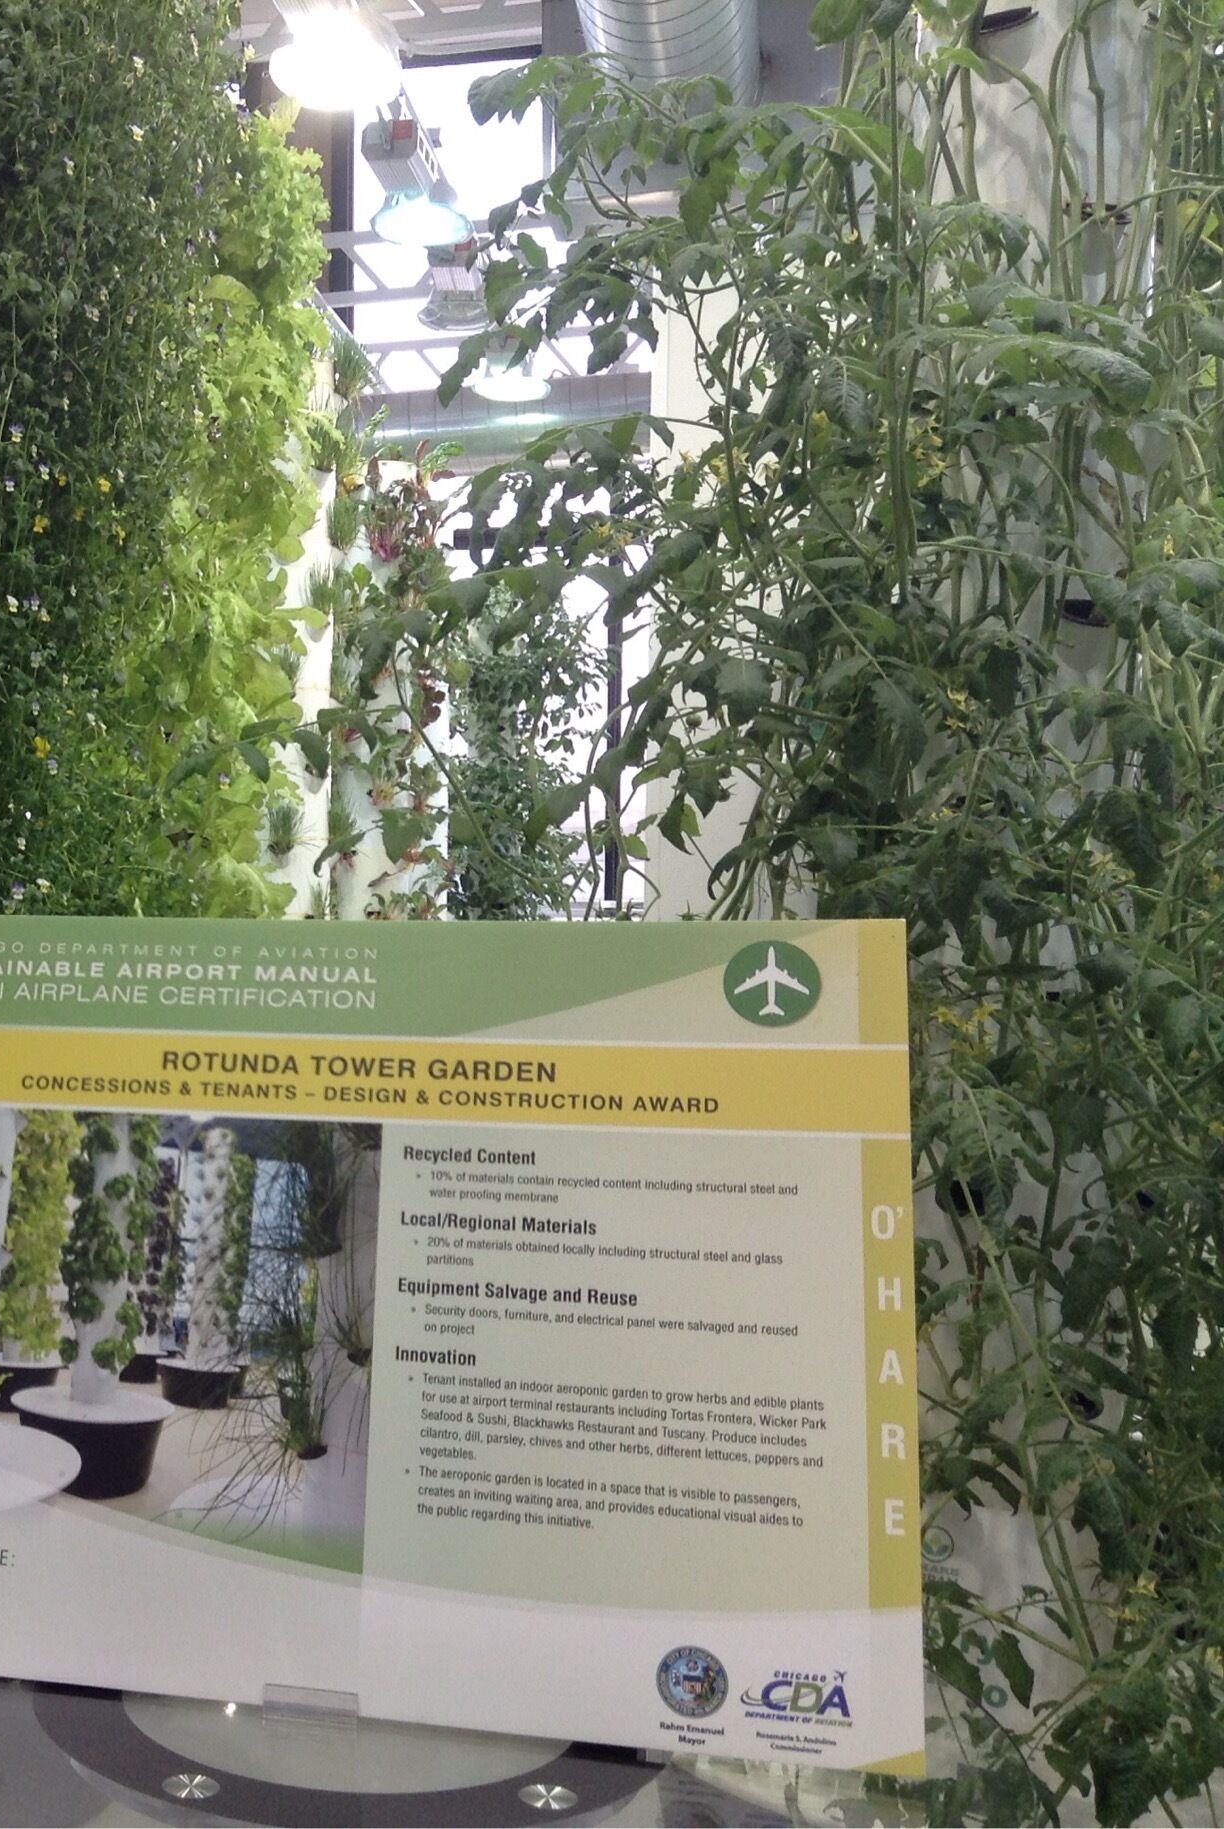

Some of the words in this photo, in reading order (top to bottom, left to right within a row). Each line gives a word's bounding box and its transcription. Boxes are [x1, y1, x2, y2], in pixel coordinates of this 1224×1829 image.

[38, 941, 198, 957] DEPARTMENT
[212, 944, 242, 958] OF
[257, 946, 378, 960] AVIATION
[116, 962, 242, 981] AIRPORT
[254, 964, 377, 984] MANUAL
[12, 981, 149, 1004] AIRPLANE
[158, 985, 376, 1010] CERTIFICATION
[161, 1050, 299, 1075] ROTUNDA
[309, 1054, 416, 1079] TOWER
[427, 1058, 556, 1083] GARDEN
[20, 1074, 171, 1096] CONCESSIONS
[178, 1080, 192, 1096] &
[200, 1081, 297, 1101] TENANTS
[323, 1085, 407, 1104] DESIGN
[415, 1088, 429, 1105] &
[437, 1089, 623, 1111] CONSTRUCTION
[632, 1095, 719, 1114] AWARD
[402, 1144, 472, 1165] Recycled
[476, 1147, 536, 1166] Content
[428, 1187, 457, 1199] water
[458, 1188, 502, 1203] proofing
[503, 1191, 559, 1204] membrane
[430, 1170, 453, 1181] 10%
[455, 1171, 466, 1182] of
[467, 1172, 515, 1185] materials
[516, 1174, 555, 1186] contain
[556, 1176, 600, 1189] recycled
[601, 1178, 642, 1190] content
[644, 1178, 693, 1195] including
[695, 1180, 747, 1194] structural
[749, 1183, 776, 1195] steel
[777, 1183, 798, 1196] and
[400, 1210, 516, 1233] Local/Regional
[521, 1215, 597, 1236] Materials
[425, 1254, 474, 1267] partitions
[426, 1235, 451, 1248] 20%
[452, 1237, 464, 1249] of
[465, 1239, 513, 1251] materials
[514, 1240, 560, 1254] obtained
[561, 1242, 596, 1258] locally
[597, 1244, 647, 1261] including
[648, 1247, 701, 1261] structural
[702, 1250, 728, 1263] steel
[730, 1251, 752, 1264] and
[753, 1251, 784, 1266] glass
[397, 1276, 480, 1298] Equipment
[484, 1281, 548, 1305] Salvage
[552, 1287, 582, 1304] and
[586, 1288, 638, 1307] Reuse
[423, 1322, 438, 1333] on
[439, 1323, 476, 1337] project
[424, 1302, 467, 1319] Security
[468, 1306, 501, 1321] doors,
[503, 1307, 552, 1324] furniture,
[553, 1312, 575, 1324] and
[576, 1312, 624, 1327] electrical
[626, 1317, 656, 1330] panel
[657, 1319, 685, 1330] were
[686, 1319, 735, 1335] salvaged
[736, 1322, 758, 1335] and
[760, 1324, 799, 1337] reused
[394, 1344, 476, 1367] Innovation
[422, 1371, 456, 1386] Tenant
[458, 1376, 502, 1390] installed
[503, 1379, 518, 1390] an
[519, 1380, 554, 1393] indoor
[555, 1383, 609, 1397] aeroponic
[610, 1386, 649, 1400] garden
[650, 1388, 663, 1401] to
[664, 1391, 694, 1404] grow
[695, 1391, 728, 1406] herbs
[729, 1394, 751, 1407] and
[752, 1395, 788, 1409] edible
[789, 1396, 825, 1412] plants
[421, 1389, 436, 1403] for
[438, 1393, 458, 1404] use
[459, 1394, 470, 1405] at
[471, 1395, 507, 1409] airport
[508, 1397, 553, 1411] terminal
[554, 1401, 615, 1416] restaurants
[617, 1404, 668, 1422] including
[670, 1407, 704, 1423] Tortas
[706, 1409, 756, 1427] Frontera,
[758, 1413, 798, 1428] Wicker
[800, 1416, 827, 1430] Park
[420, 1407, 463, 1423] Seafood
[465, 1411, 474, 1424] &
[477, 1411, 510, 1428] Sushi,
[512, 1414, 575, 1431] Blackhawks
[576, 1419, 635, 1436] Restaurant
[637, 1425, 658, 1438] and
[661, 1425, 708, 1443] Tuscany.
[711, 1428, 757, 1445] Produce
[759, 1432, 808, 1448] includes
[418, 1446, 476, 1461] vegetables.
[419, 1426, 462, 1442] cilantro,
[464, 1429, 484, 1444] dill,
[485, 1433, 526, 1448] parsley,
[528, 1434, 564, 1449] chives
[564, 1438, 586, 1451] and
[587, 1440, 616, 1453] other
[618, 1441, 653, 1457] herbs,
[655, 1444, 702, 1460] different
[704, 1447, 752, 1464] lettuces,
[753, 1453, 800, 1467] peppers
[802, 1455, 824, 1468] and
[418, 1464, 438, 1479] The
[440, 1469, 492, 1483] aeroponic
[494, 1472, 531, 1486] garden
[533, 1474, 544, 1488] is
[545, 1475, 585, 1491] located
[586, 1479, 598, 1492] in
[599, 1482, 607, 1493] a
[609, 1482, 642, 1496] space
[643, 1483, 666, 1497] that
[668, 1485, 678, 1499] is
[680, 1487, 716, 1501] visible
[718, 1489, 731, 1502] to
[733, 1492, 801, 1509] passengers,
[416, 1485, 456, 1498] creates
[457, 1488, 471, 1500] an
[473, 1488, 512, 1506] inviting
[514, 1494, 553, 1509] waiting
[555, 1496, 582, 1510] area,
[584, 1499, 606, 1512] and
[607, 1501, 655, 1516] provides
[656, 1504, 721, 1521] educational
[722, 1510, 757, 1524] visual
[758, 1512, 790, 1527] aides
[791, 1514, 804, 1528] to
[416, 1502, 434, 1516] the
[435, 1504, 468, 1518] public
[470, 1508, 522, 1525] regarding
[523, 1511, 544, 1525] this
[546, 1514, 595, 1529] initiative.
[773, 1670, 826, 1682] CHICAGO
[761, 1679, 851, 1718] CDA
[678, 1735, 705, 1745] Mayor
[687, 1725, 724, 1735] Emanuel
